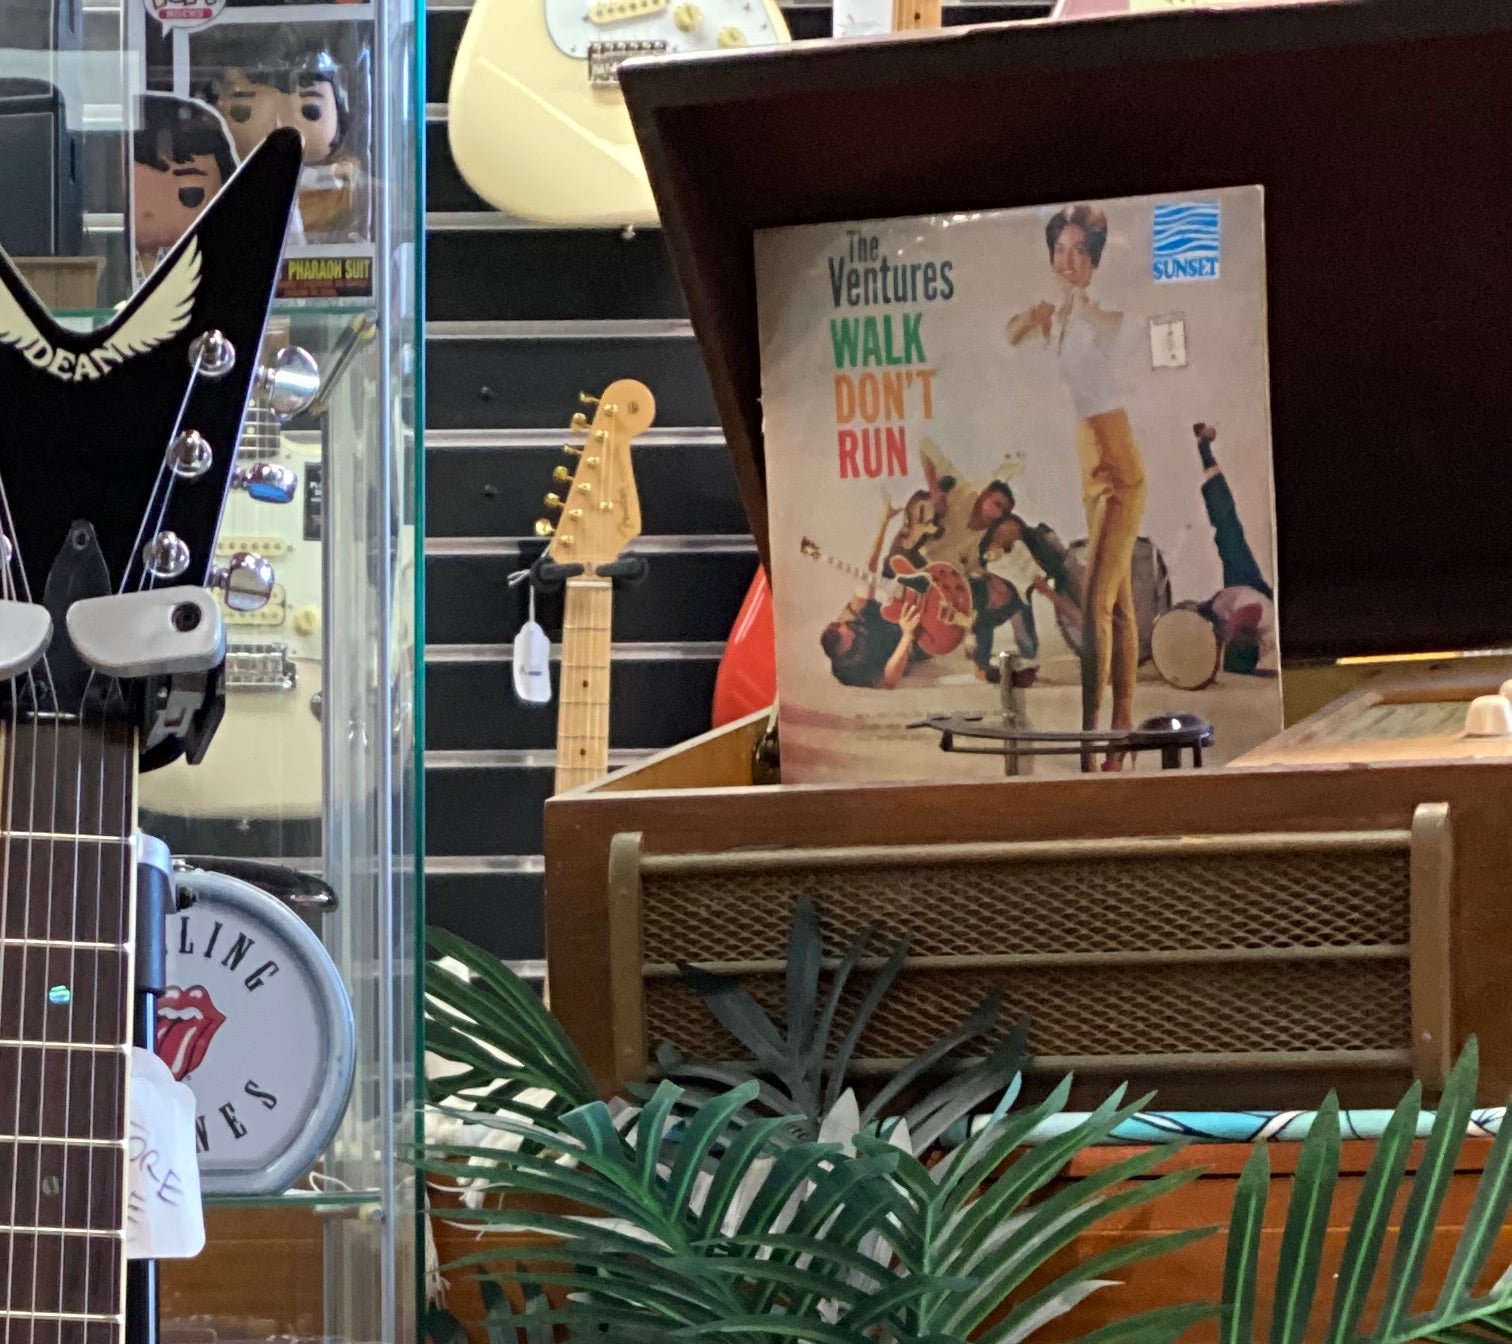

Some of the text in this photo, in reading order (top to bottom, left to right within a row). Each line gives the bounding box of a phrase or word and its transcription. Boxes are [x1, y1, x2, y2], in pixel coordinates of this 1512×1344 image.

[289, 259, 370, 280] PHARAOH SUIT
[846, 229, 879, 263] The
[1152, 256, 1218, 281] SUNSET
[828, 256, 954, 307] Ventures
[23, 338, 124, 382] DEAN
[830, 312, 926, 368] WALK
[834, 369, 937, 424] DON'T
[838, 426, 908, 479] RUN
[178, 916, 280, 992] LING
